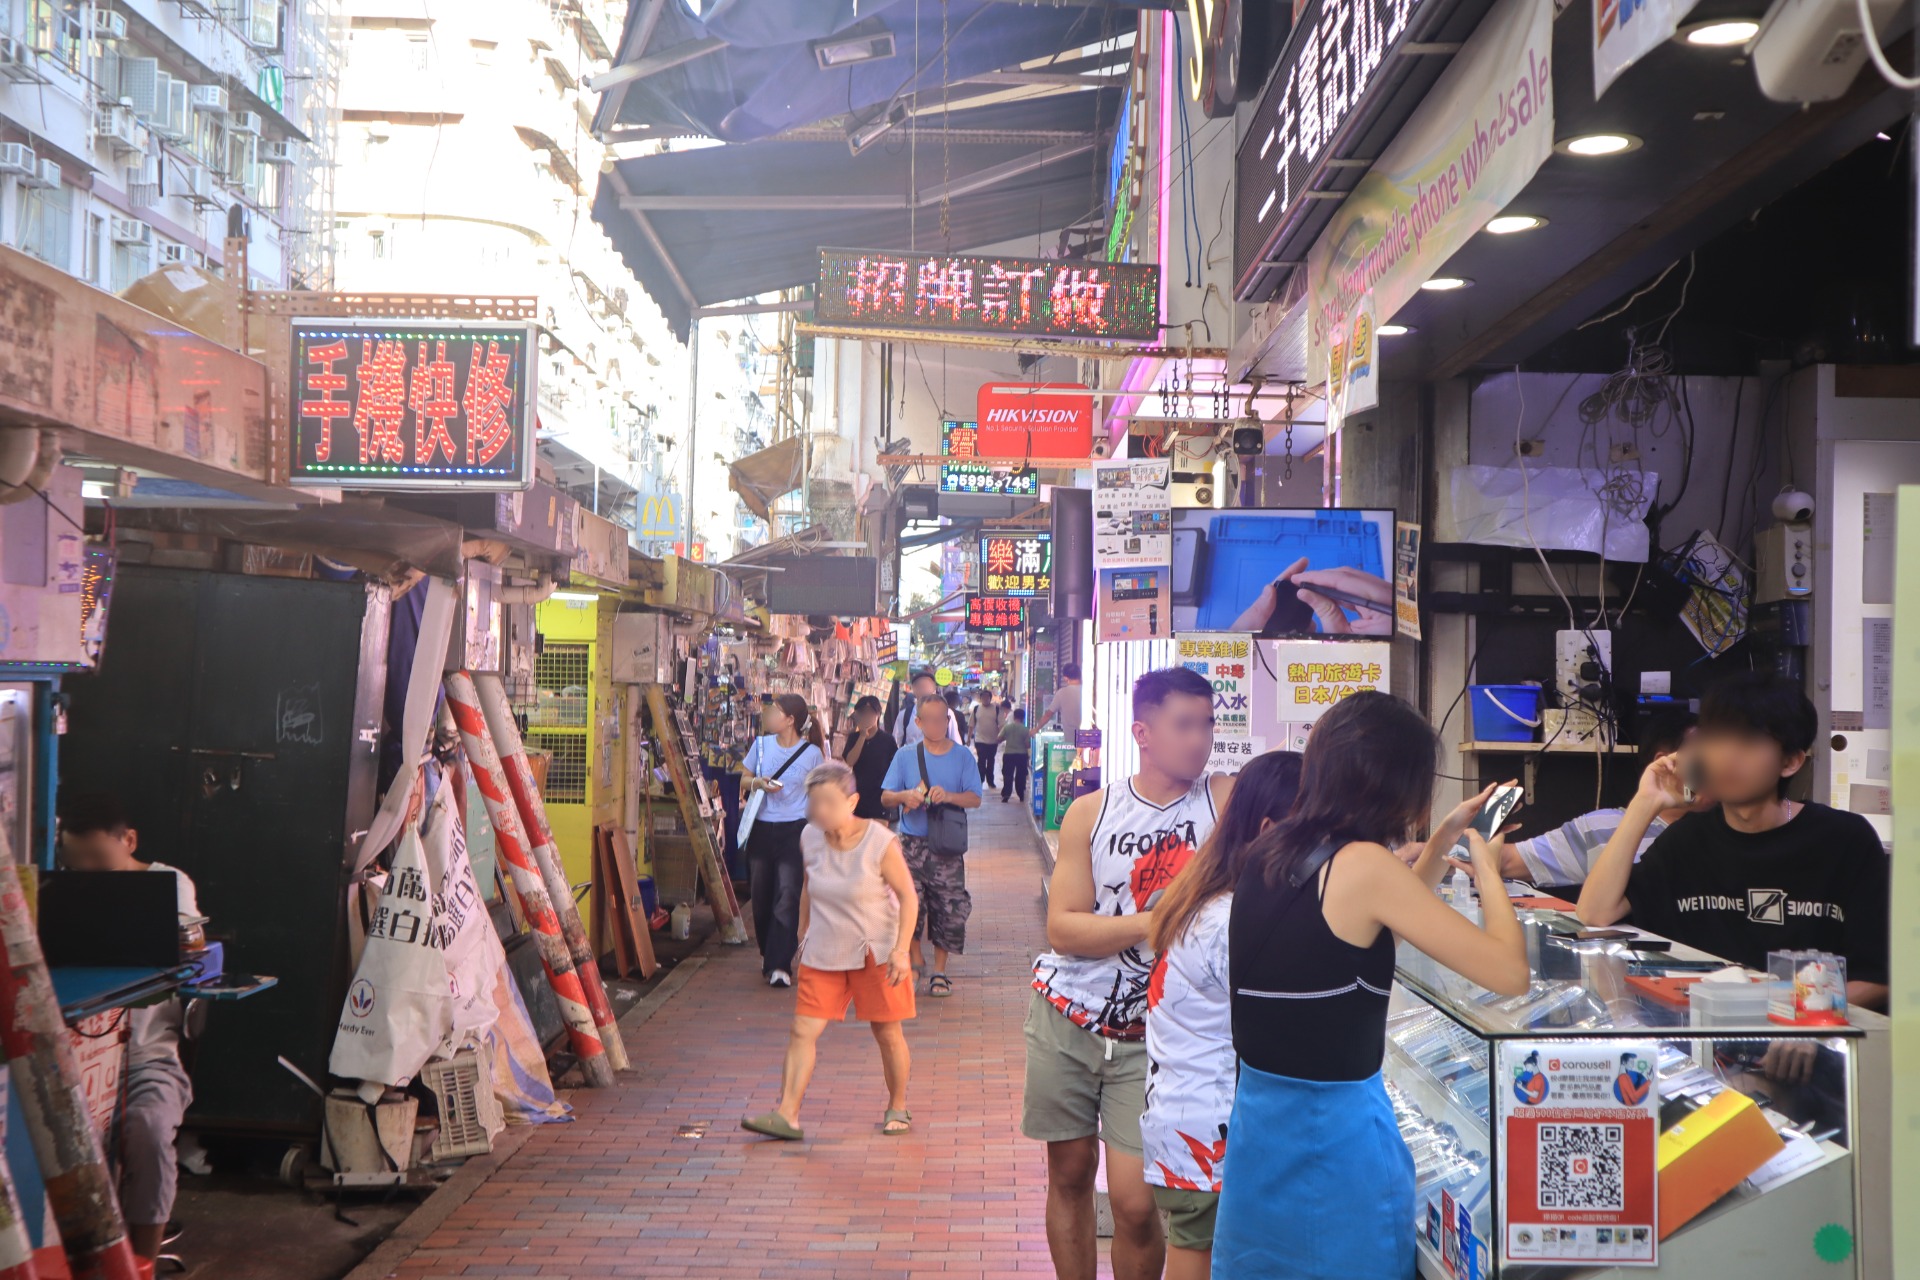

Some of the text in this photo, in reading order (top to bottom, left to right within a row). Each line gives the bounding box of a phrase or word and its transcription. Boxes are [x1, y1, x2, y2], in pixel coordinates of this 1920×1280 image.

[1367, 208, 1411, 287] mobile
[1411, 162, 1460, 254] phone
[302, 338, 513, 466] 手機快修
[987, 408, 1079, 423] HIKVISION
[1001, 425, 1026, 433] Security
[988, 538, 1051, 574] 樂滿
[988, 575, 1051, 590] 歡迎男女
[970, 598, 1021, 612] 高價收機
[970, 612, 1021, 627] 專業維修
[1179, 640, 1249, 658] 專業維修
[1216, 663, 1245, 680] 中毒
[1288, 662, 1383, 683] 熱門旅遊卡
[1209, 679, 1237, 693] ON
[1213, 693, 1248, 710] 入水
[1227, 758, 1244, 768] Play
[361, 1026, 376, 1037] Ever
[1563, 1059, 1611, 1071] carousell
